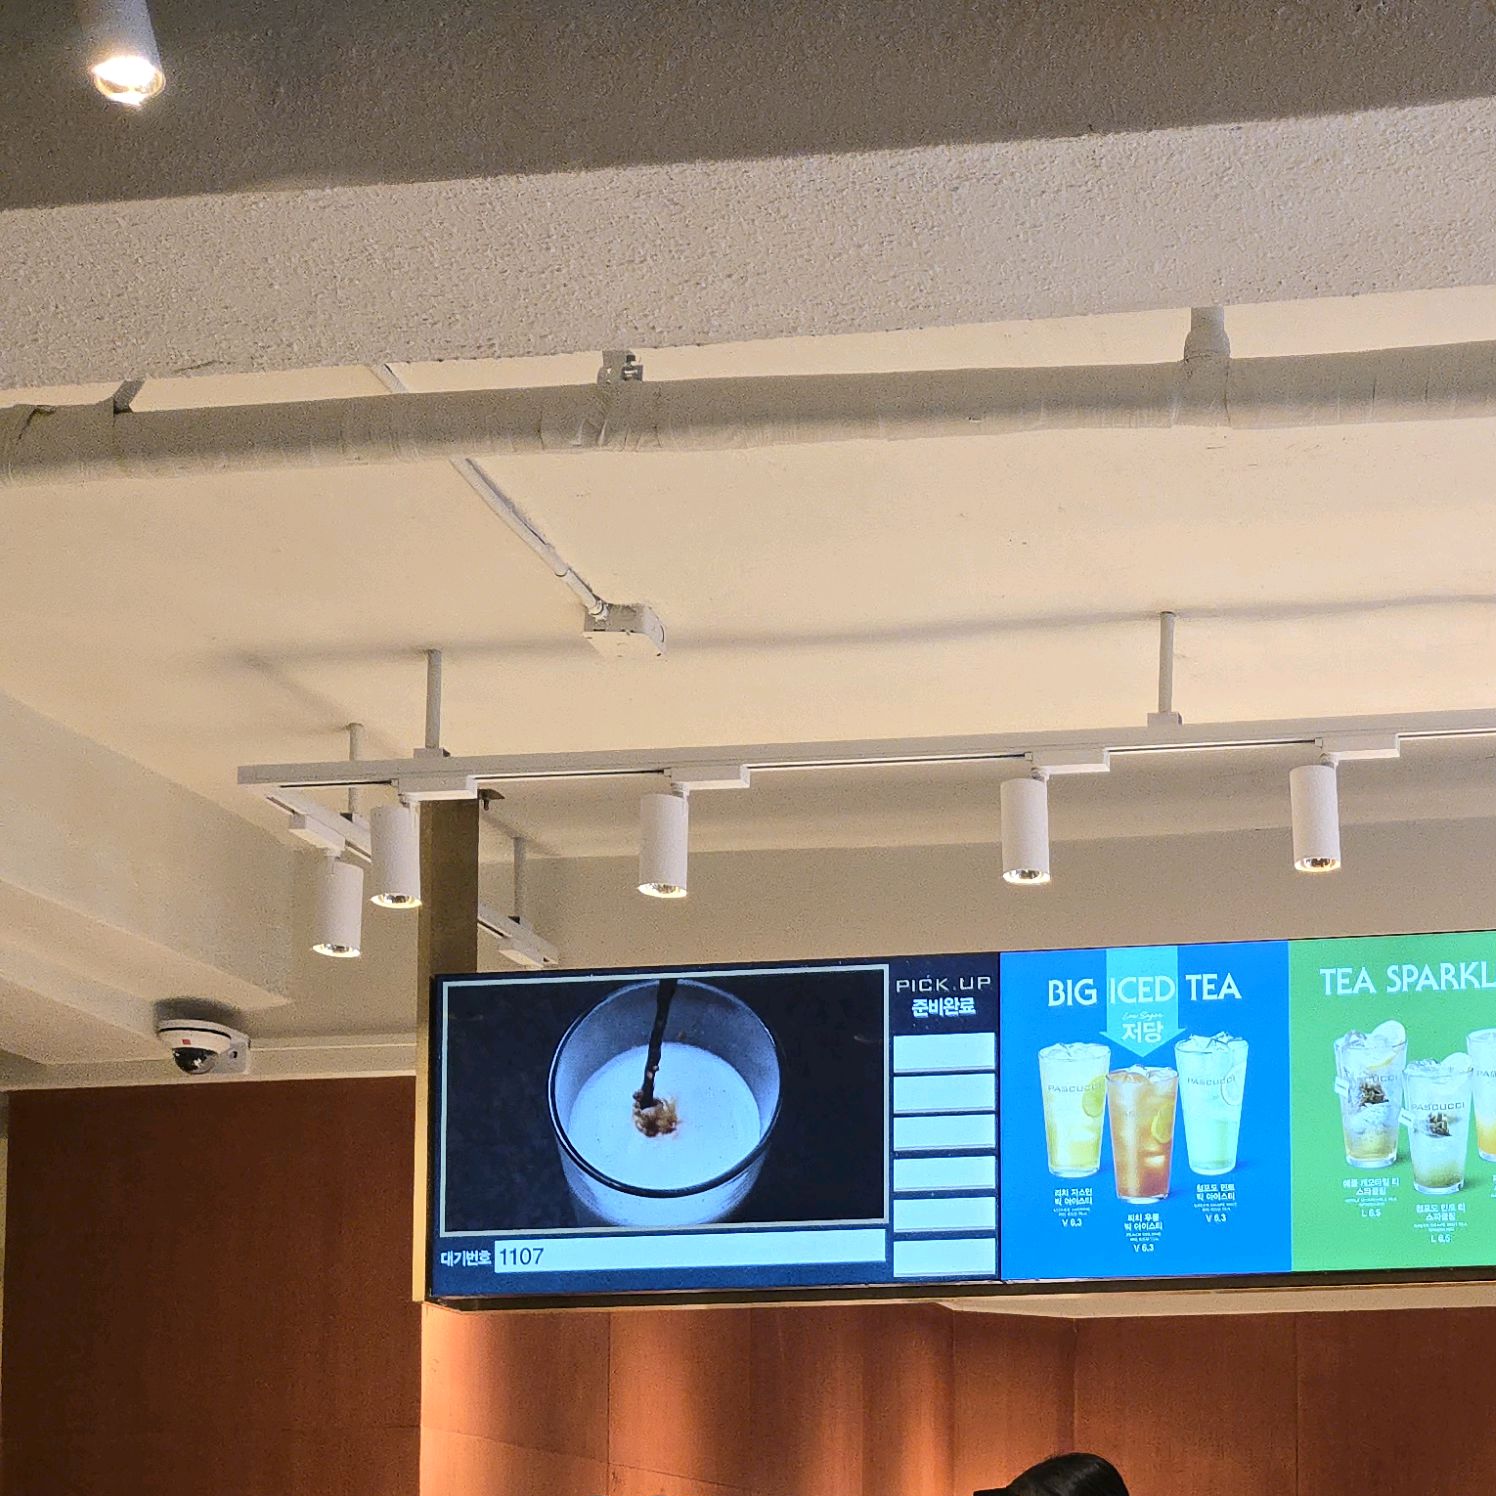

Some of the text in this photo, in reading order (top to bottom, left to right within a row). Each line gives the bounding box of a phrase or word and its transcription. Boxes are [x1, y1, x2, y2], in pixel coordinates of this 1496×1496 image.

[896, 977, 992, 993] PICK UP
[1048, 973, 1241, 1006] BIG ICED TEA
[1320, 967, 1376, 995] TEA
[912, 996, 976, 1017] 준비완료
[1122, 1022, 1163, 1043] 저당
[1411, 1103, 1464, 1111] PASCUCCI
[441, 1247, 544, 1267] 대기번호 1107
[1142, 1244, 1154, 1252] 6.3
